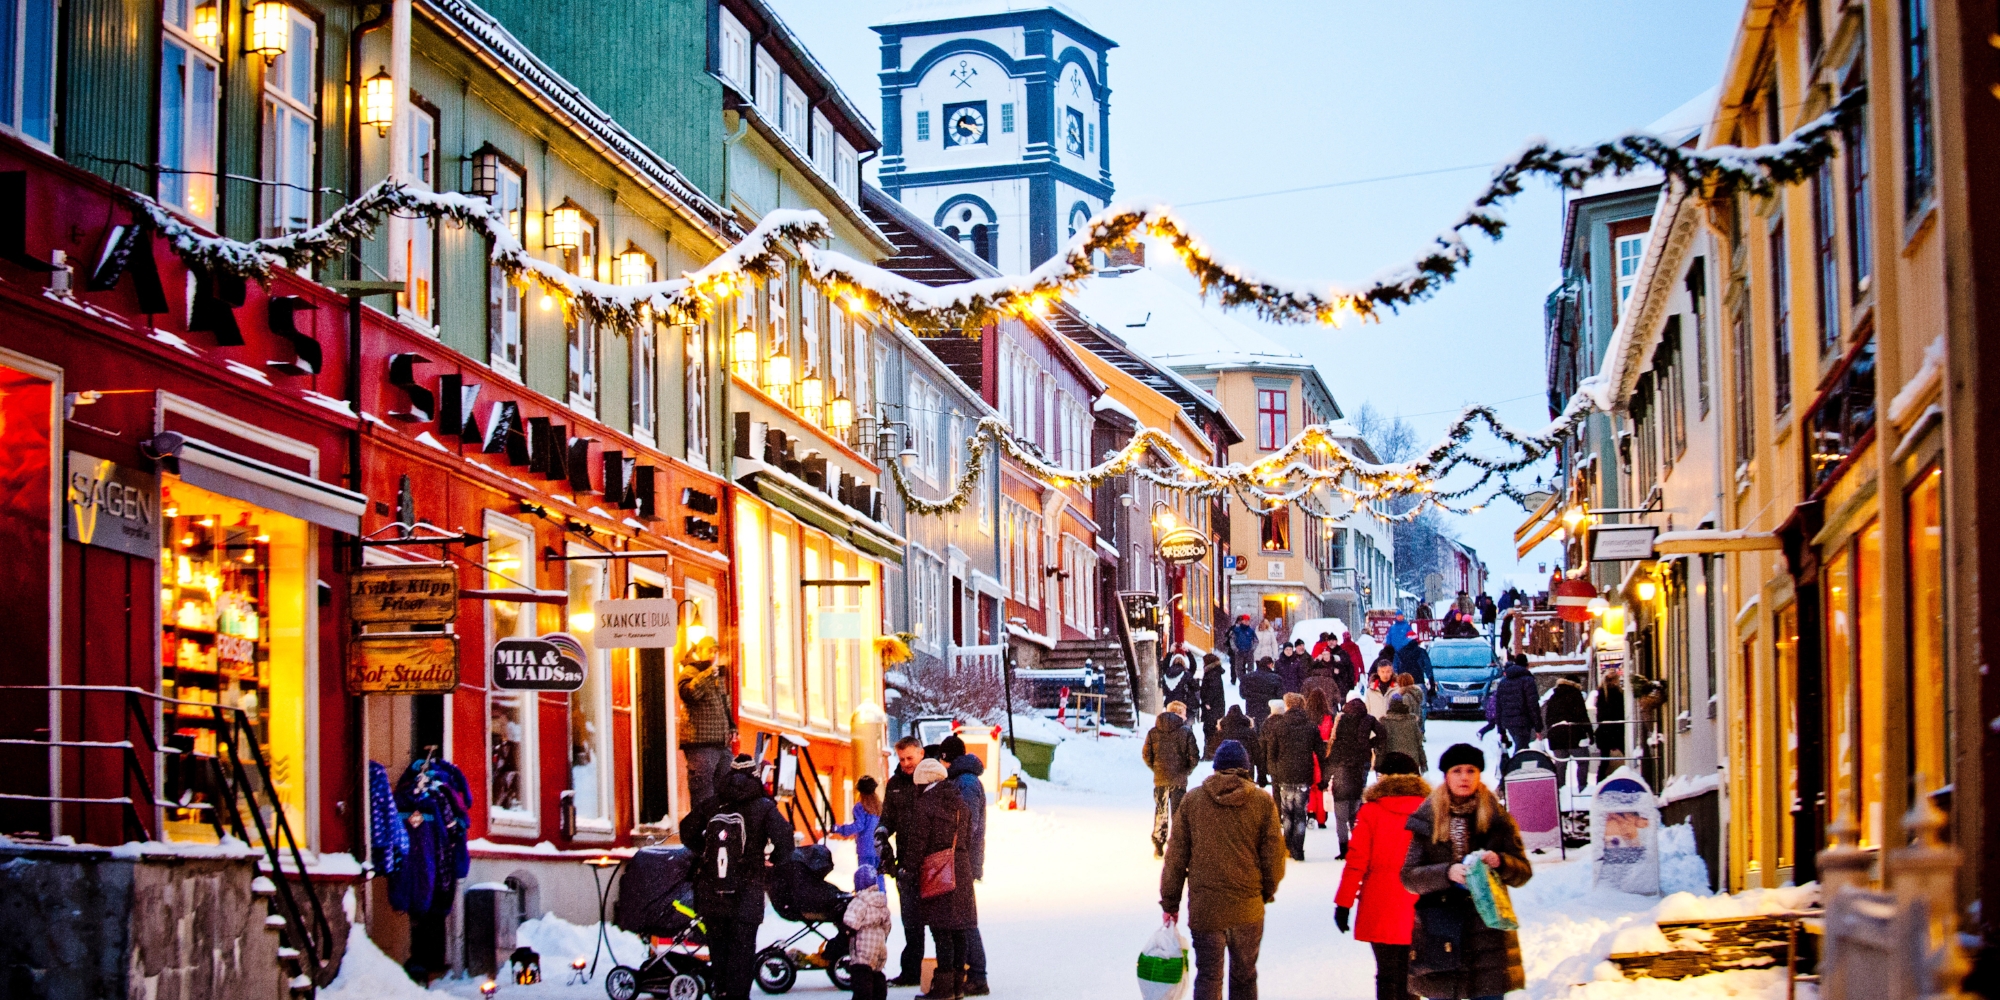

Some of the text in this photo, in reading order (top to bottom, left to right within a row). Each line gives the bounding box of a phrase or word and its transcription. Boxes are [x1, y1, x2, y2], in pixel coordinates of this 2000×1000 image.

[388, 353, 664, 522] SKANCKE
[72, 471, 152, 525] SAGEN
[1226, 557, 1234, 568] P
[407, 579, 451, 596] Klipp
[601, 612, 672, 629] SKANCKE BUA
[496, 650, 560, 666] MIA &
[392, 663, 453, 682] Studio
